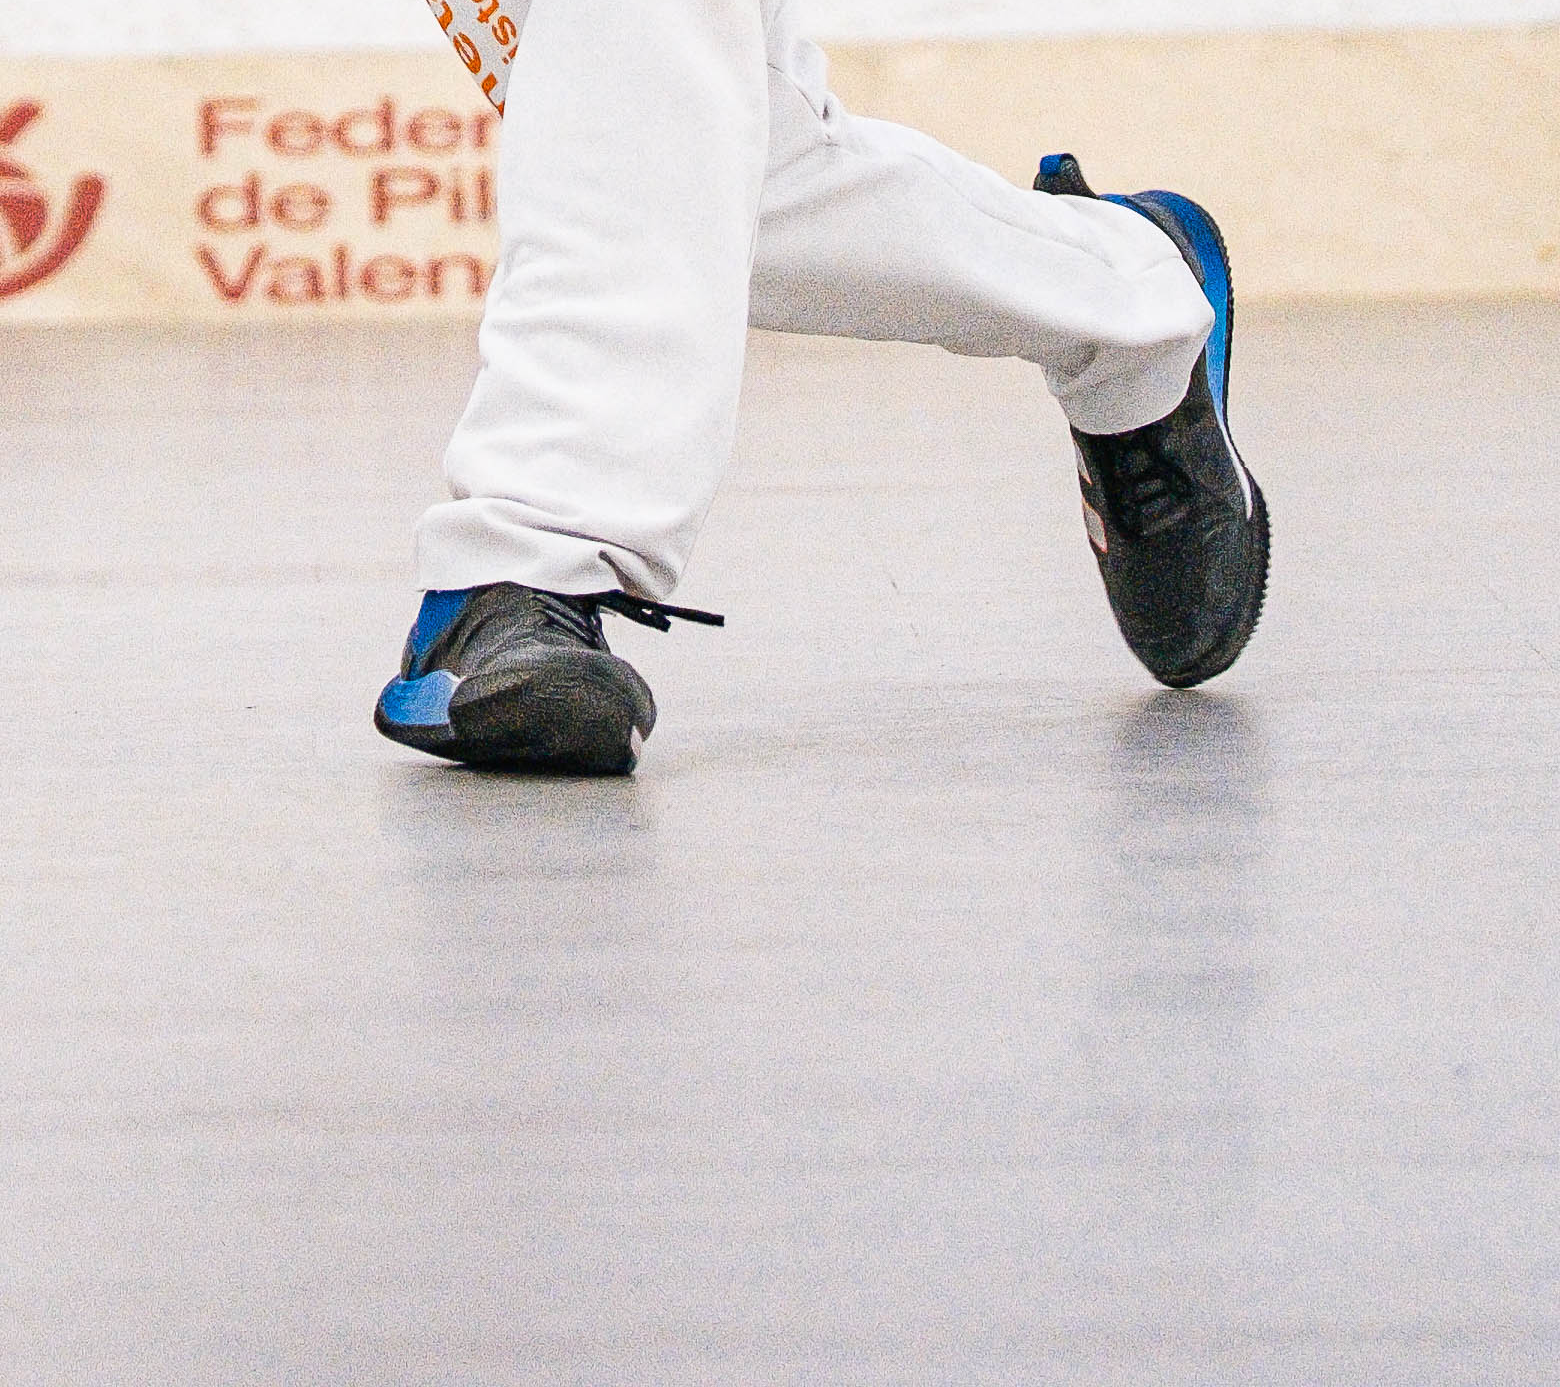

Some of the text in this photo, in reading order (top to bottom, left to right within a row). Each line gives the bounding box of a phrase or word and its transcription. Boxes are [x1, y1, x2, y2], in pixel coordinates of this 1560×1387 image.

[196, 95, 497, 159] Feder
[195, 165, 497, 232] de Pil
[195, 240, 486, 308] Valen
